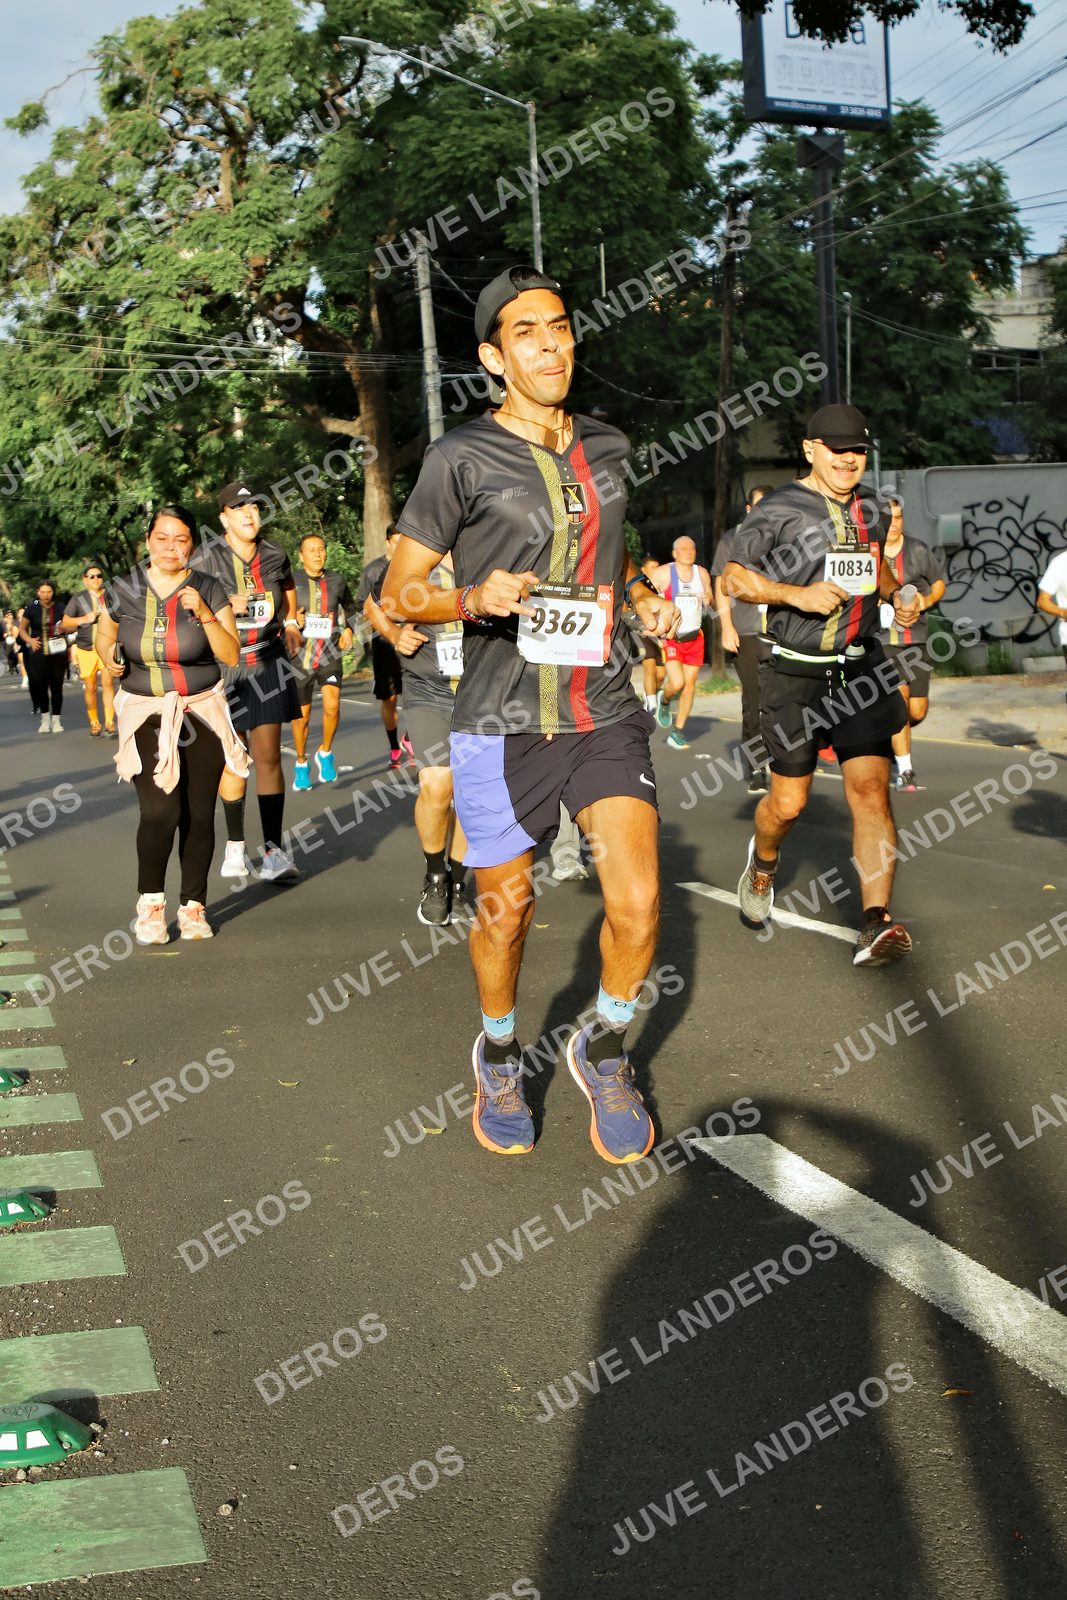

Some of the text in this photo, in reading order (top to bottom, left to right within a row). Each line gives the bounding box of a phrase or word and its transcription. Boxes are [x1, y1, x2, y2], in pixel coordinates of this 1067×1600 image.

[963, 495, 1029, 520] TOY
[830, 560, 873, 577] 10834
[308, 620, 328, 630] 9992
[530, 607, 593, 636] 9367
